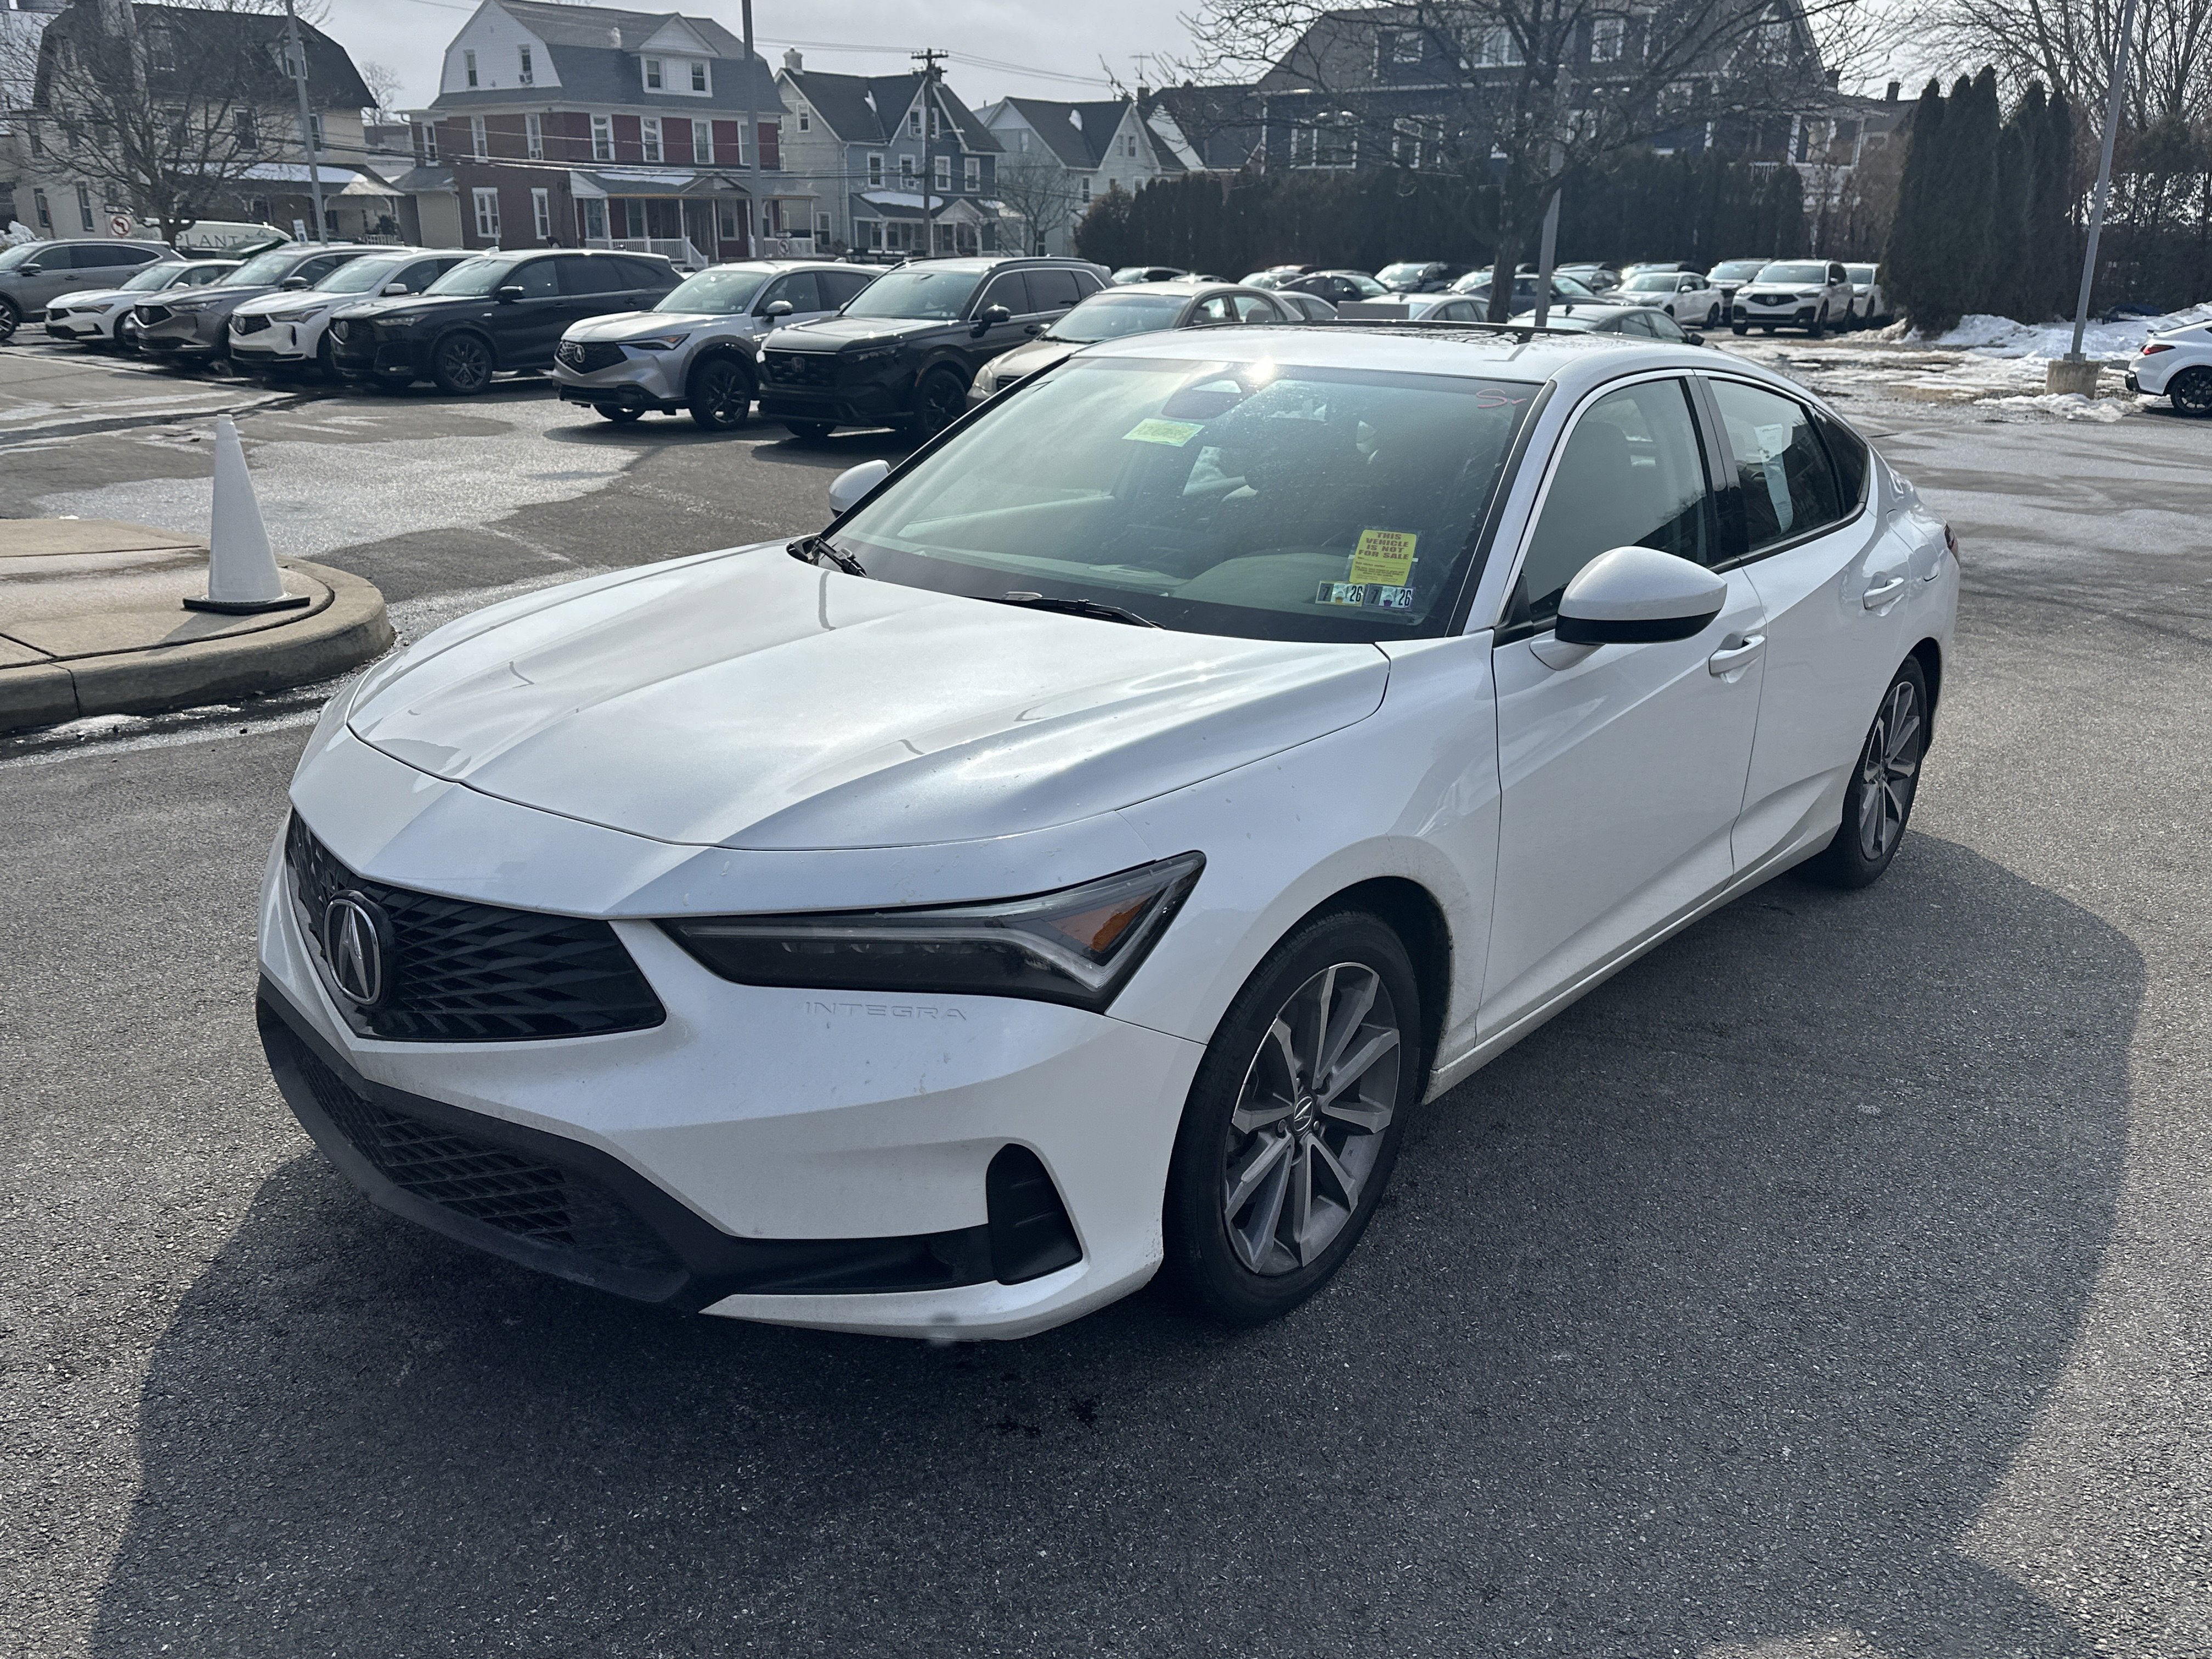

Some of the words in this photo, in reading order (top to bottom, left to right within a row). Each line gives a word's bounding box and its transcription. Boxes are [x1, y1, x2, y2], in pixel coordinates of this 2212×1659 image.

[1365, 538, 1409, 548] VEHICLE
[1358, 549, 1379, 557] FOR
[1350, 585, 1363, 602] 26
[1398, 589, 1412, 606] 26
[806, 1002, 967, 1020] INTEGRA
